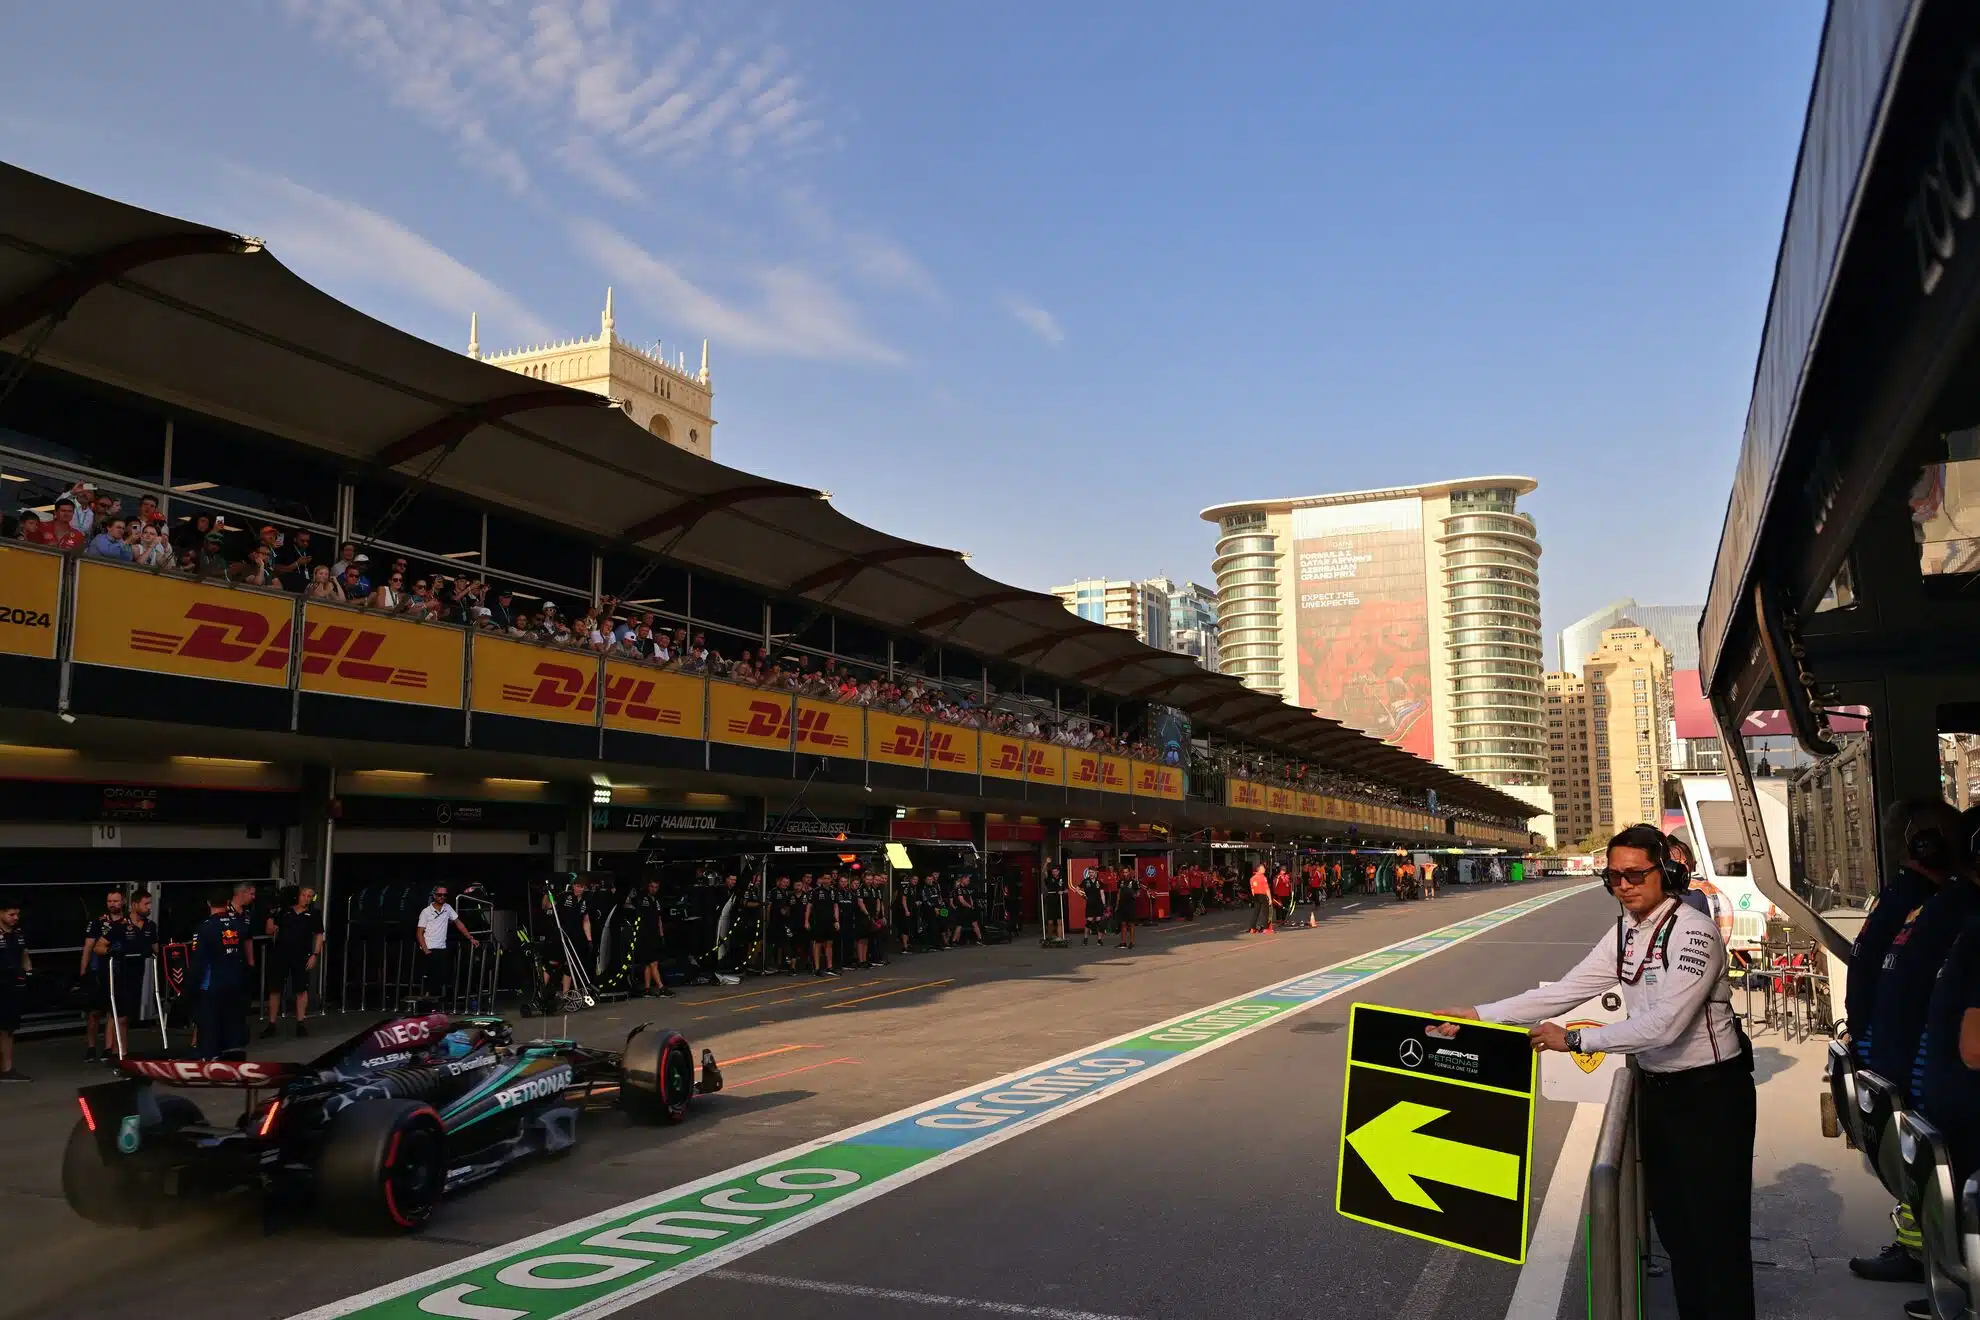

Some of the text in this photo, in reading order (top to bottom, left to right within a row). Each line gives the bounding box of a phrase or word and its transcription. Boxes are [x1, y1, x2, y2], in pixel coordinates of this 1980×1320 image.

[1301, 573, 1332, 581] GRAND
[1302, 593, 1335, 601] EXPECT
[1302, 598, 1360, 608] UNEXPECTED
[0, 607, 51, 628] 2024
[176, 602, 395, 683] DHL
[529, 662, 661, 721] DHL
[746, 701, 835, 745] DHL
[894, 725, 953, 761] DHL
[1000, 744, 1047, 776] DHL
[1080, 758, 1116, 784] DHL
[104, 788, 157, 798] ORACLE
[660, 815, 717, 829] HAMILTON
[99, 824, 115, 840] 10
[437, 834, 447, 846] 11
[1689, 938, 1708, 948] IWC
[1690, 931, 1714, 941] SOLERA
[1677, 964, 1696, 974] AMD
[1149, 1005, 1281, 1042] aramco
[373, 1021, 430, 1048] INEOS
[369, 1053, 408, 1066] SOLERA
[1428, 1054, 1479, 1068] PETRONAS
[1450, 1050, 1479, 1061] AMG
[133, 1061, 272, 1086] INEOS
[1434, 1062, 1455, 1070] FORMULA
[495, 1070, 573, 1109] PETRONAS
[915, 1058, 1146, 1129] aramco
